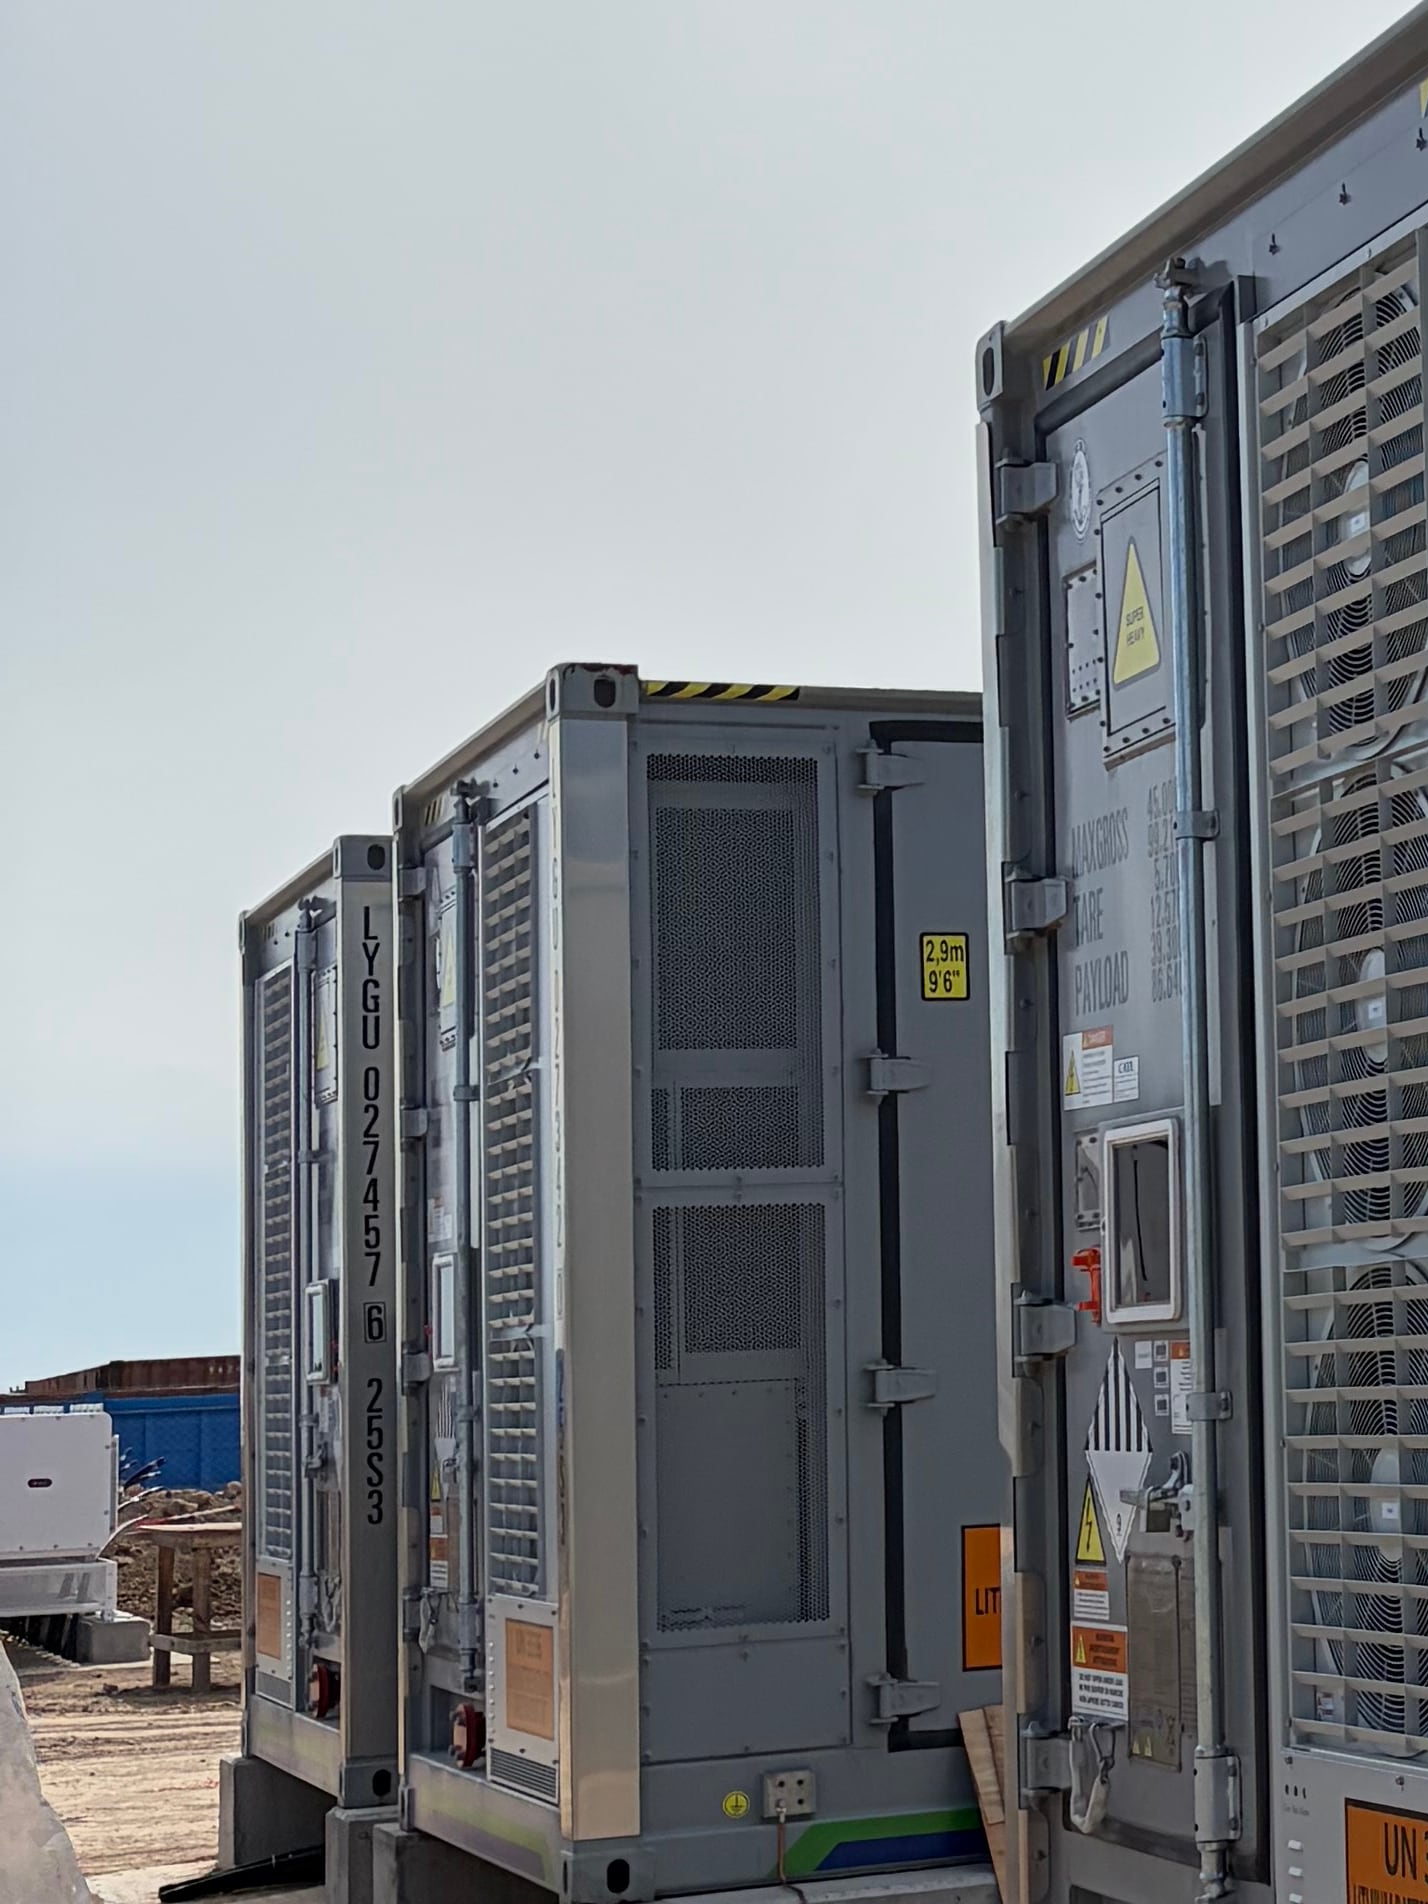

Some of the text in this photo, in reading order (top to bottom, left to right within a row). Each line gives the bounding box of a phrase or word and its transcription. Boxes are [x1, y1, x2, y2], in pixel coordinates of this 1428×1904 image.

[1073, 888, 1104, 946] TARE
[925, 939, 964, 966] 2,9m
[1074, 950, 1129, 1016] PAYLOAD
[361, 906, 384, 1525] LYGU 027457 6 25S3
[1384, 1821, 1417, 1880] UN
